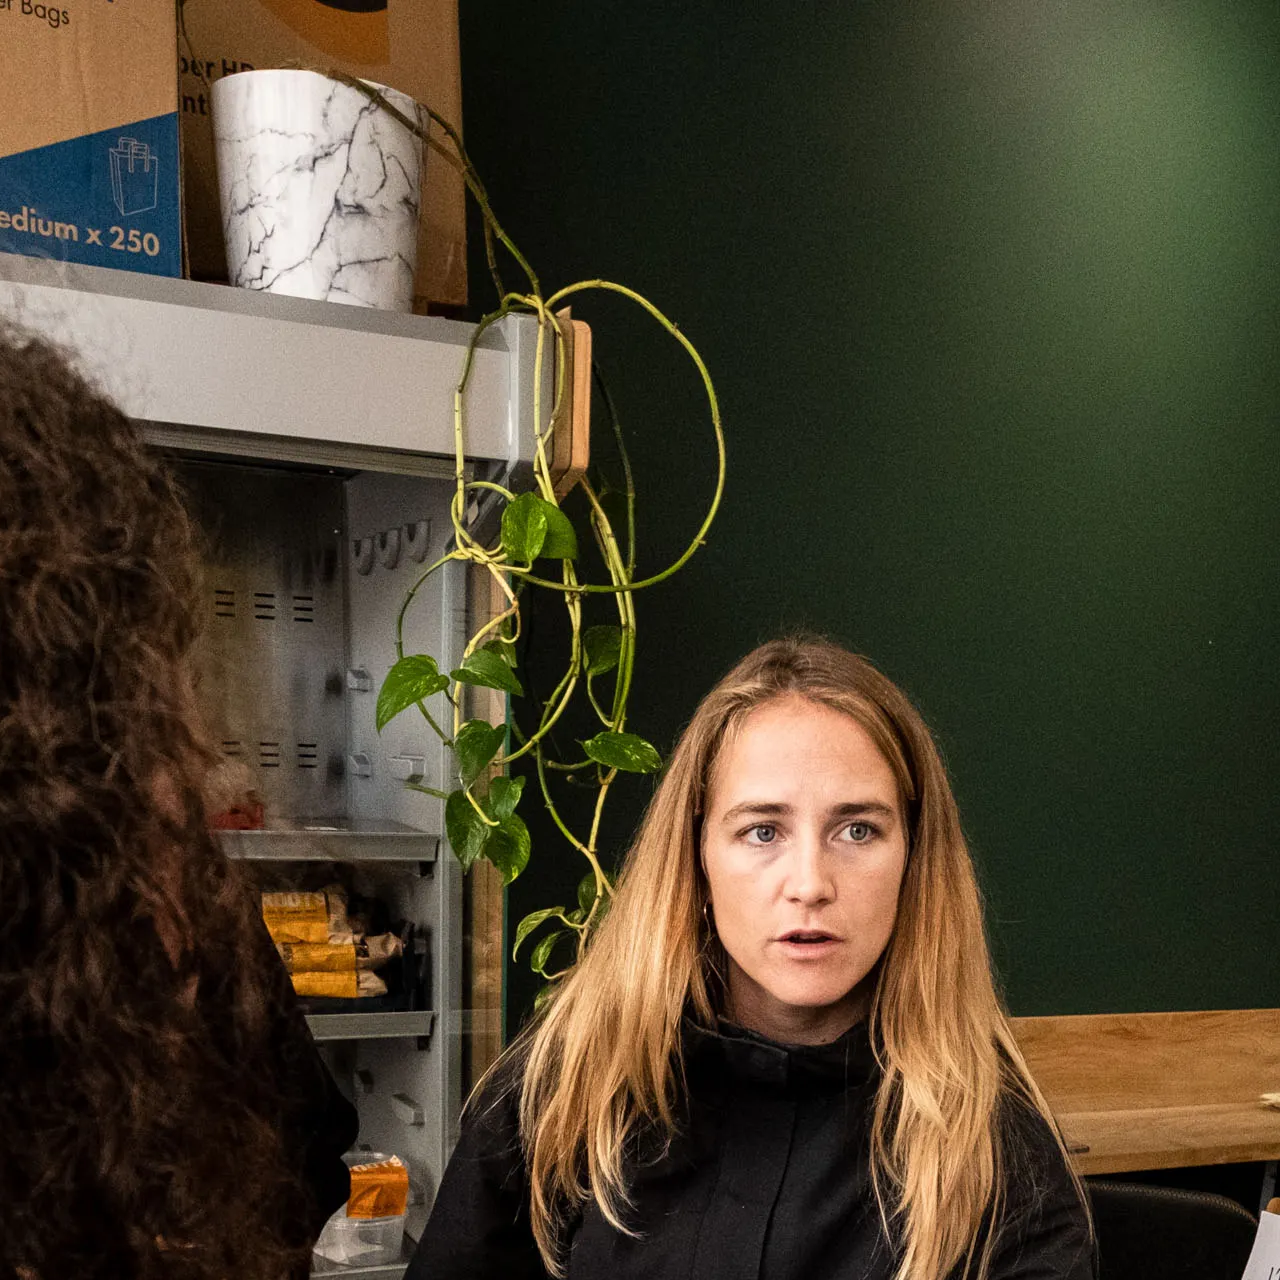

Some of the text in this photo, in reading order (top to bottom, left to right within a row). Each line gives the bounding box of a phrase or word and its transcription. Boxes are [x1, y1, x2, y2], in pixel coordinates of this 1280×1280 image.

[21, 0, 69, 28] Bags
[86, 227, 104, 246] x
[109, 225, 160, 257] 250
